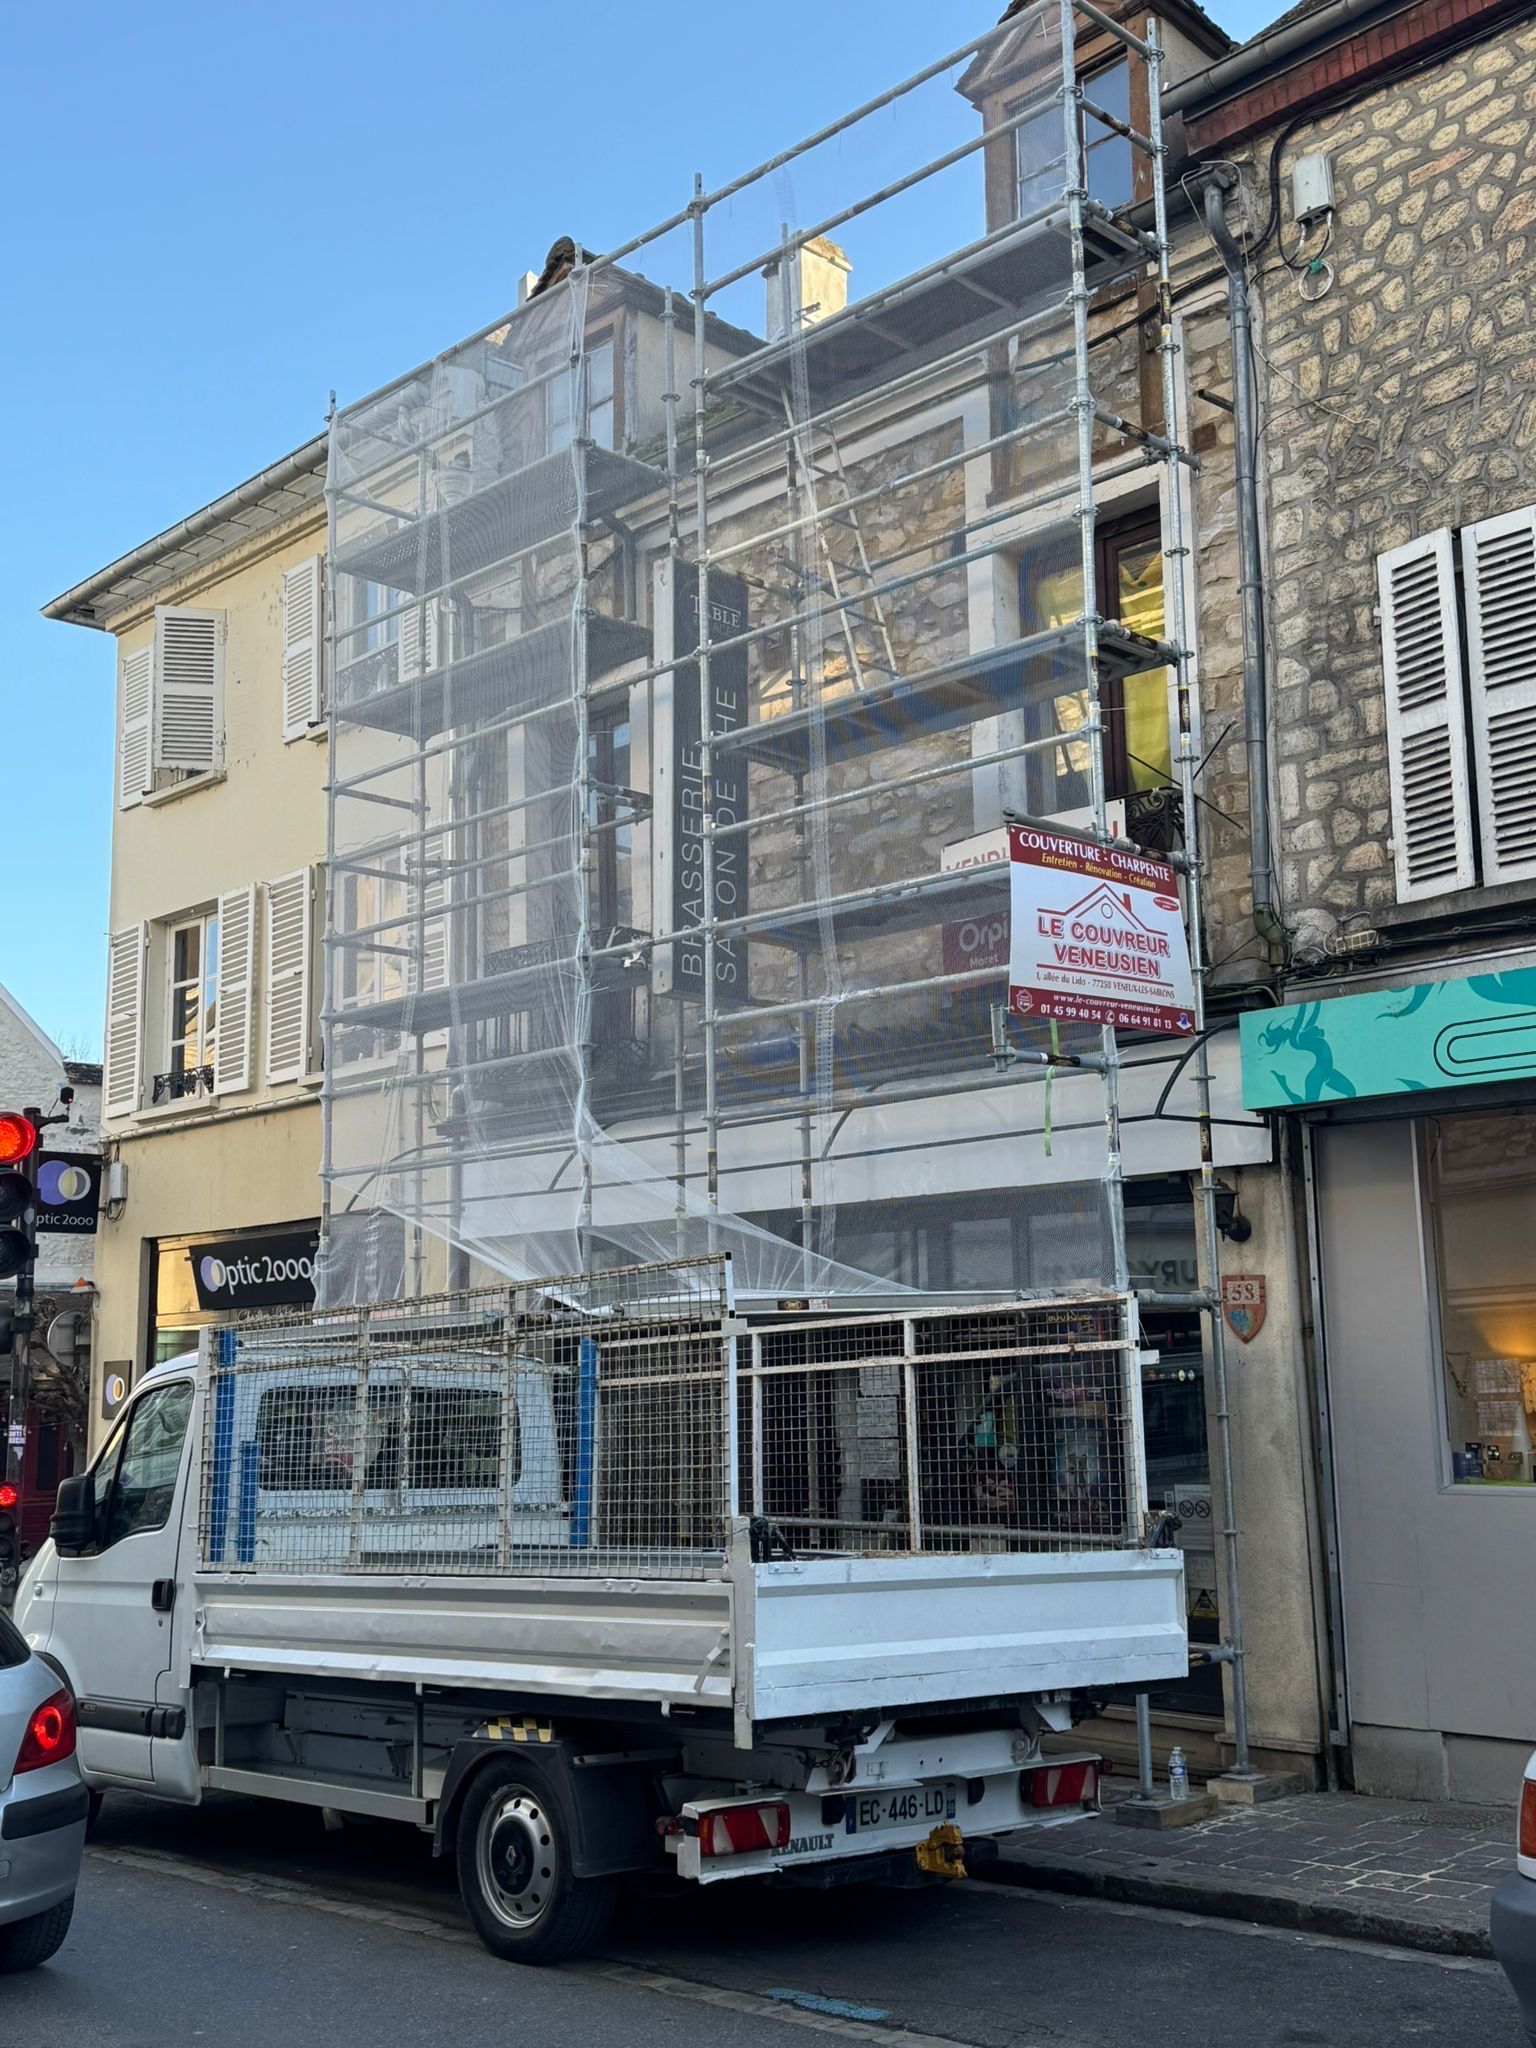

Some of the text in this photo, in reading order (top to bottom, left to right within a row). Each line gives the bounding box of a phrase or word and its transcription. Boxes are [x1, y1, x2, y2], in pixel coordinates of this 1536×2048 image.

[690, 594, 741, 628] TBLE
[715, 686, 737, 984] SAON DE HE
[681, 746, 703, 977] BRASSERIE
[1019, 831, 1101, 862] COUVERTURE
[1110, 853, 1170, 882] CHARPENTE
[1042, 852, 1078, 869] Entretien
[1085, 861, 1123, 880] Rénovation
[1129, 873, 1157, 889] Création
[959, 910, 1008, 953] Orpi
[1037, 916, 1171, 959] LE COUVREUR
[1053, 943, 1161, 979] VENEUSIEN
[1043, 971, 1060, 982] allée
[1061, 974, 1070, 984] du
[1071, 975, 1086, 986] Lido
[1092, 978, 1112, 989] 77250
[1040, 1003, 1173, 1030] 01 45 99 40 54 06 64 91 81 13
[1053, 994, 1161, 1015] www.le-couvreur-veneusien.fr
[36, 1212, 94, 1228] ptic 2000
[211, 1255, 312, 1296] Optic 2000
[1231, 1283, 1255, 1301] 58
[770, 1832, 835, 1858] RENAULT
